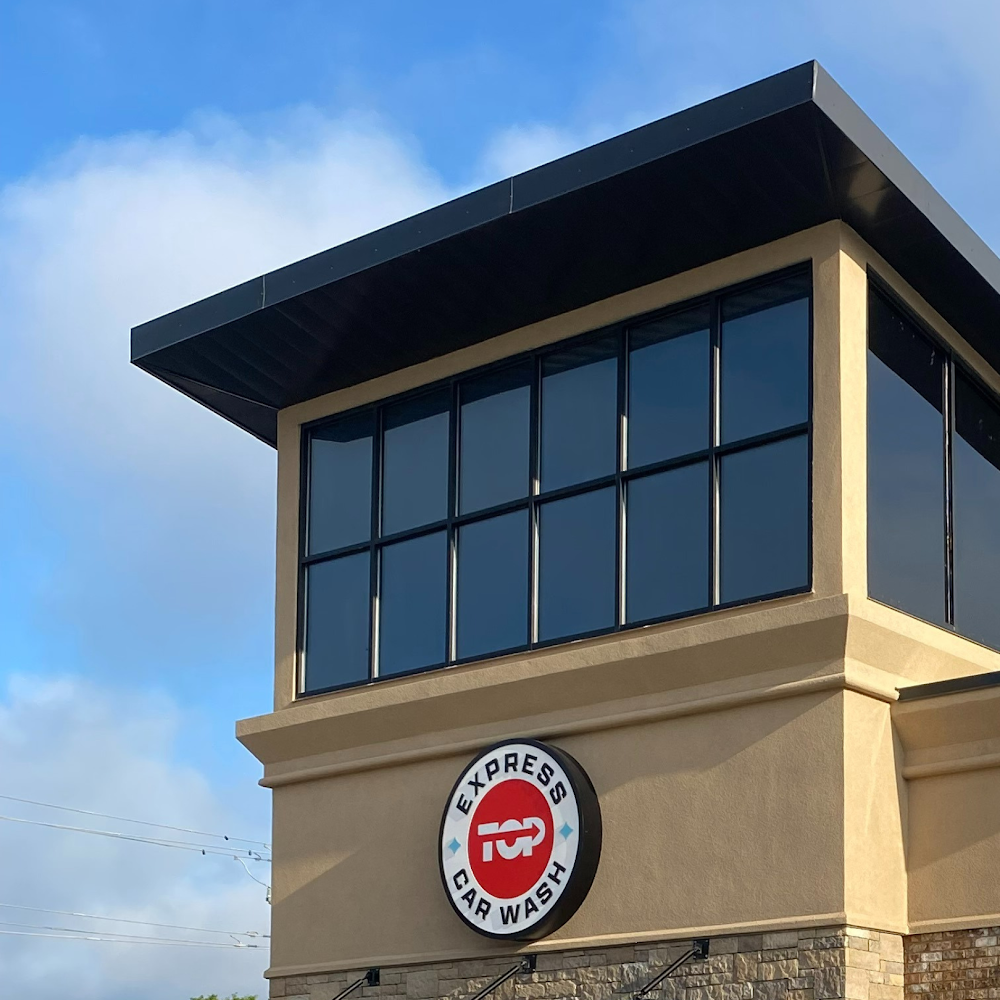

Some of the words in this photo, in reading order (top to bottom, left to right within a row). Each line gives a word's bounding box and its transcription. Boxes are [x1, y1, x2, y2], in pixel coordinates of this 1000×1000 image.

[456, 752, 567, 815] EXPRESS
[477, 816, 546, 862] TOP
[452, 868, 492, 921] CAR
[499, 860, 567, 925] WASH
